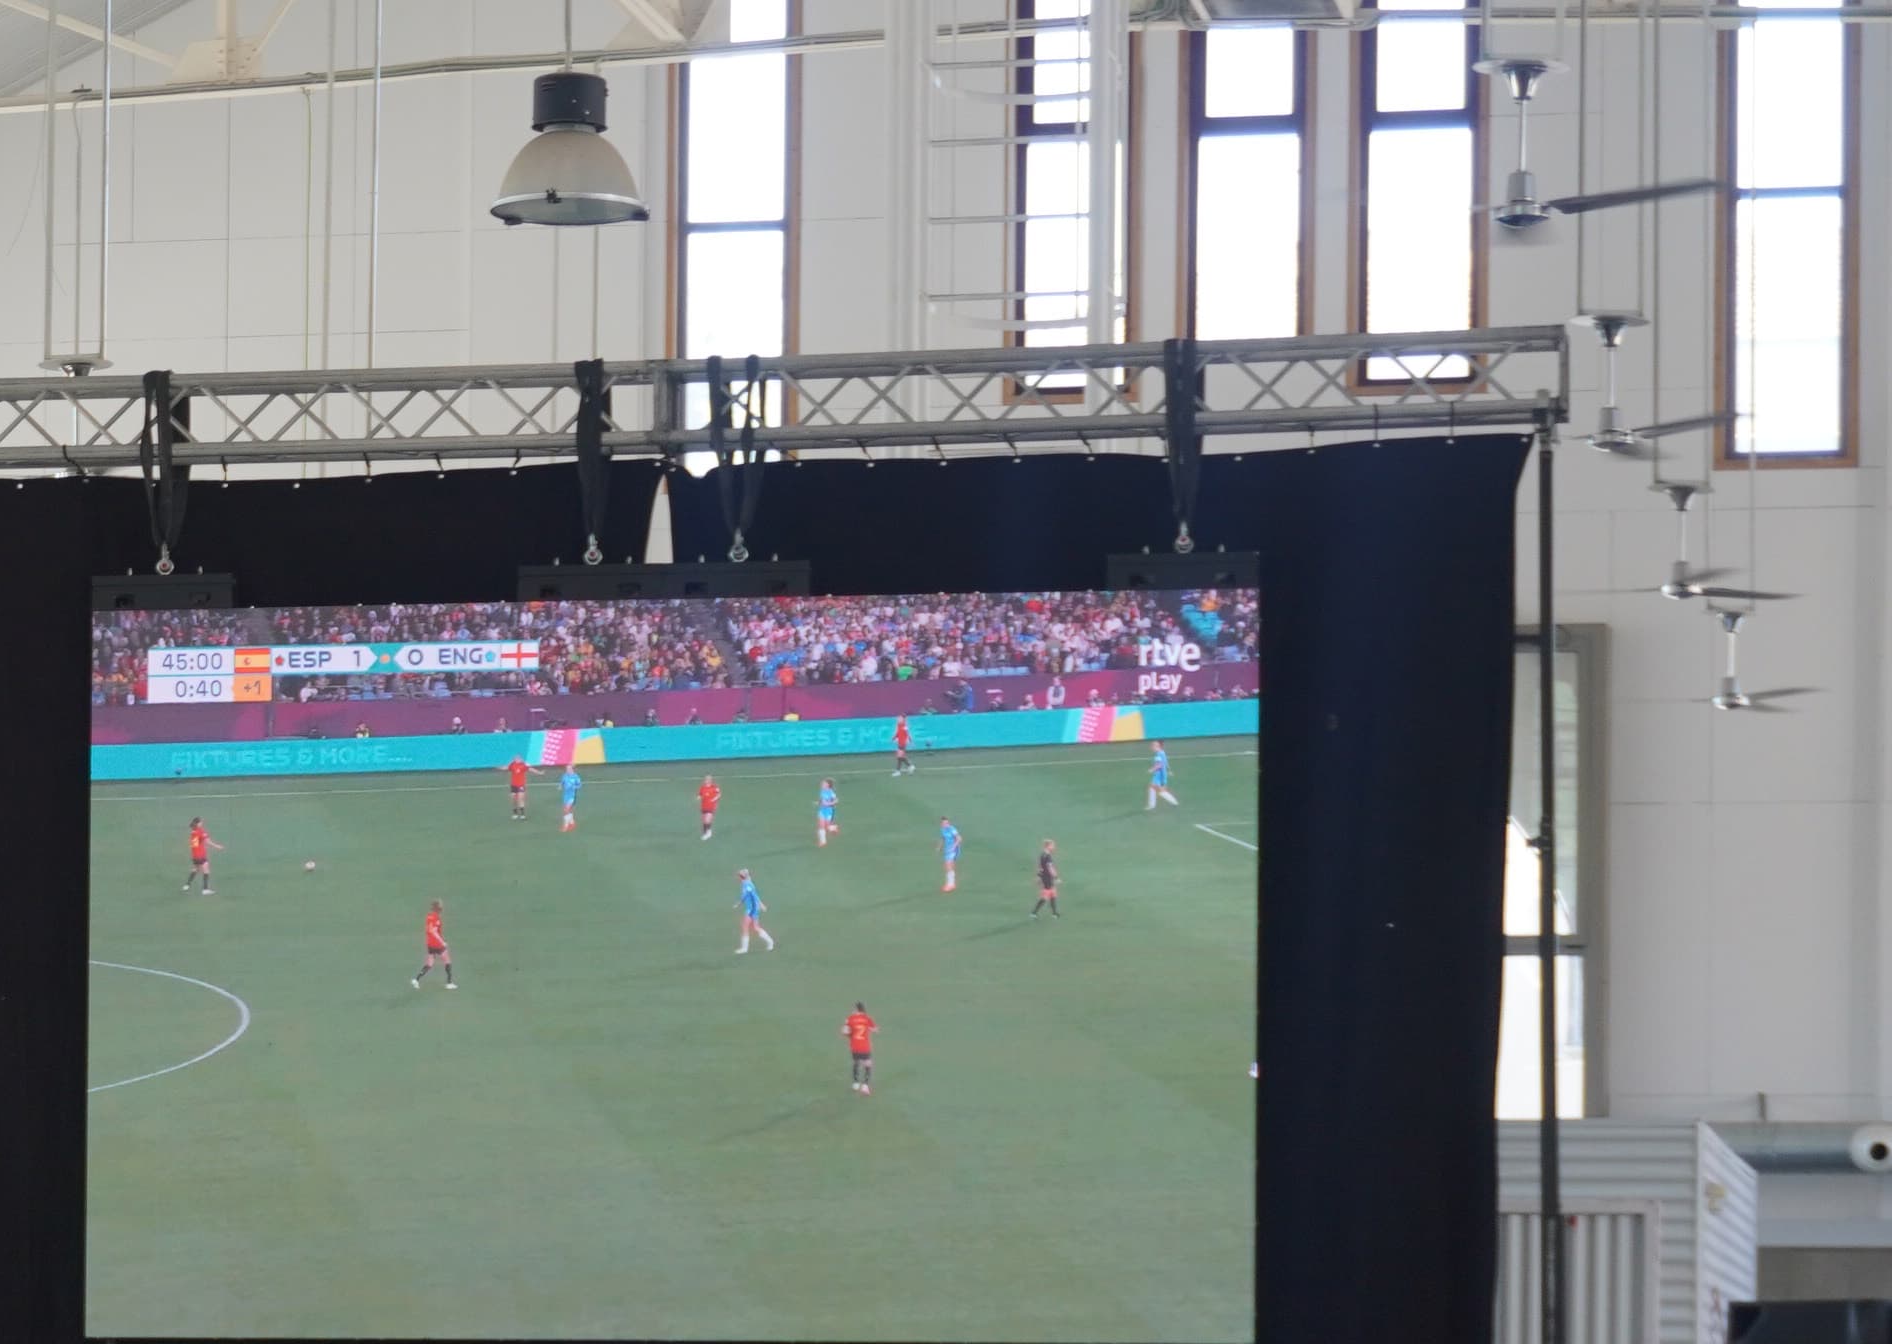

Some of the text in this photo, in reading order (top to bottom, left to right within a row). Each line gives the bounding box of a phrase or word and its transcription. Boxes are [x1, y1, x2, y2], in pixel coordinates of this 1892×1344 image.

[162, 647, 483, 671] 45:00 ESP 1 0 ENG
[1138, 638, 1201, 672] rtve
[175, 680, 222, 698] 0:40
[1138, 672, 1182, 695] play
